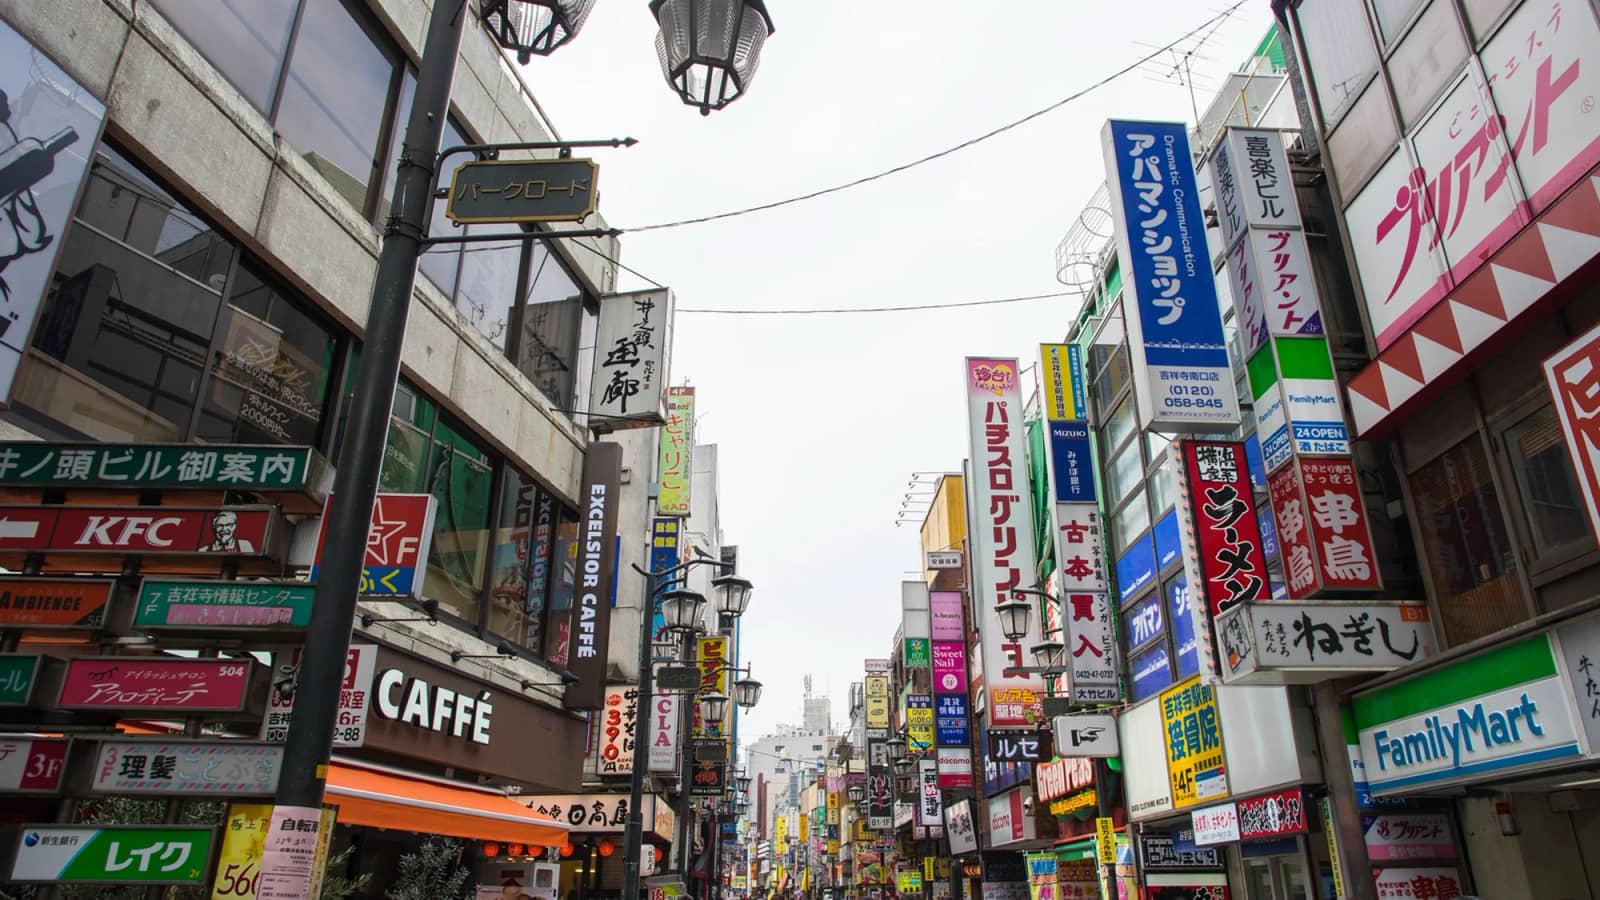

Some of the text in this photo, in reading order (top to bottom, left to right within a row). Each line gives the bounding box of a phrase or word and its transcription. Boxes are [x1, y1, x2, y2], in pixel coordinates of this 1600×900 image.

[458, 177, 590, 201] パークロード
[1244, 136, 1285, 219] 喜楽ビル
[1375, 53, 1580, 305] ブリアント
[1163, 135, 1196, 277] Dramatic Communication
[1126, 133, 1186, 325] アパマンショップ
[1268, 231, 1304, 330] ブリアント
[1164, 398, 1224, 408] 058-845
[1169, 385, 1214, 396] (0120)
[1288, 395, 1337, 406] FamilyMart
[1054, 428, 1087, 437] MIZUHO
[75, 516, 183, 547] KFC
[1202, 484, 1264, 609] ラーメン
[1310, 489, 1372, 581] 串鳥
[576, 483, 606, 660] EXCELSIOR CAFFÉ
[167, 587, 305, 605] 吉祥寺情報センター
[1292, 611, 1419, 662] ねぎし
[218, 666, 244, 677] 504
[933, 651, 964, 663] Sweet
[934, 663, 955, 676] Nail
[377, 668, 494, 745] CAFFÉ
[1077, 688, 1116, 700] 大竹ビル
[1168, 704, 1220, 762] 接骨院
[1373, 692, 1544, 770] FamilyMart
[27, 753, 63, 778] 3F
[118, 755, 177, 779] 理髪
[938, 757, 970, 765] docomo
[105, 841, 193, 872] レイク
